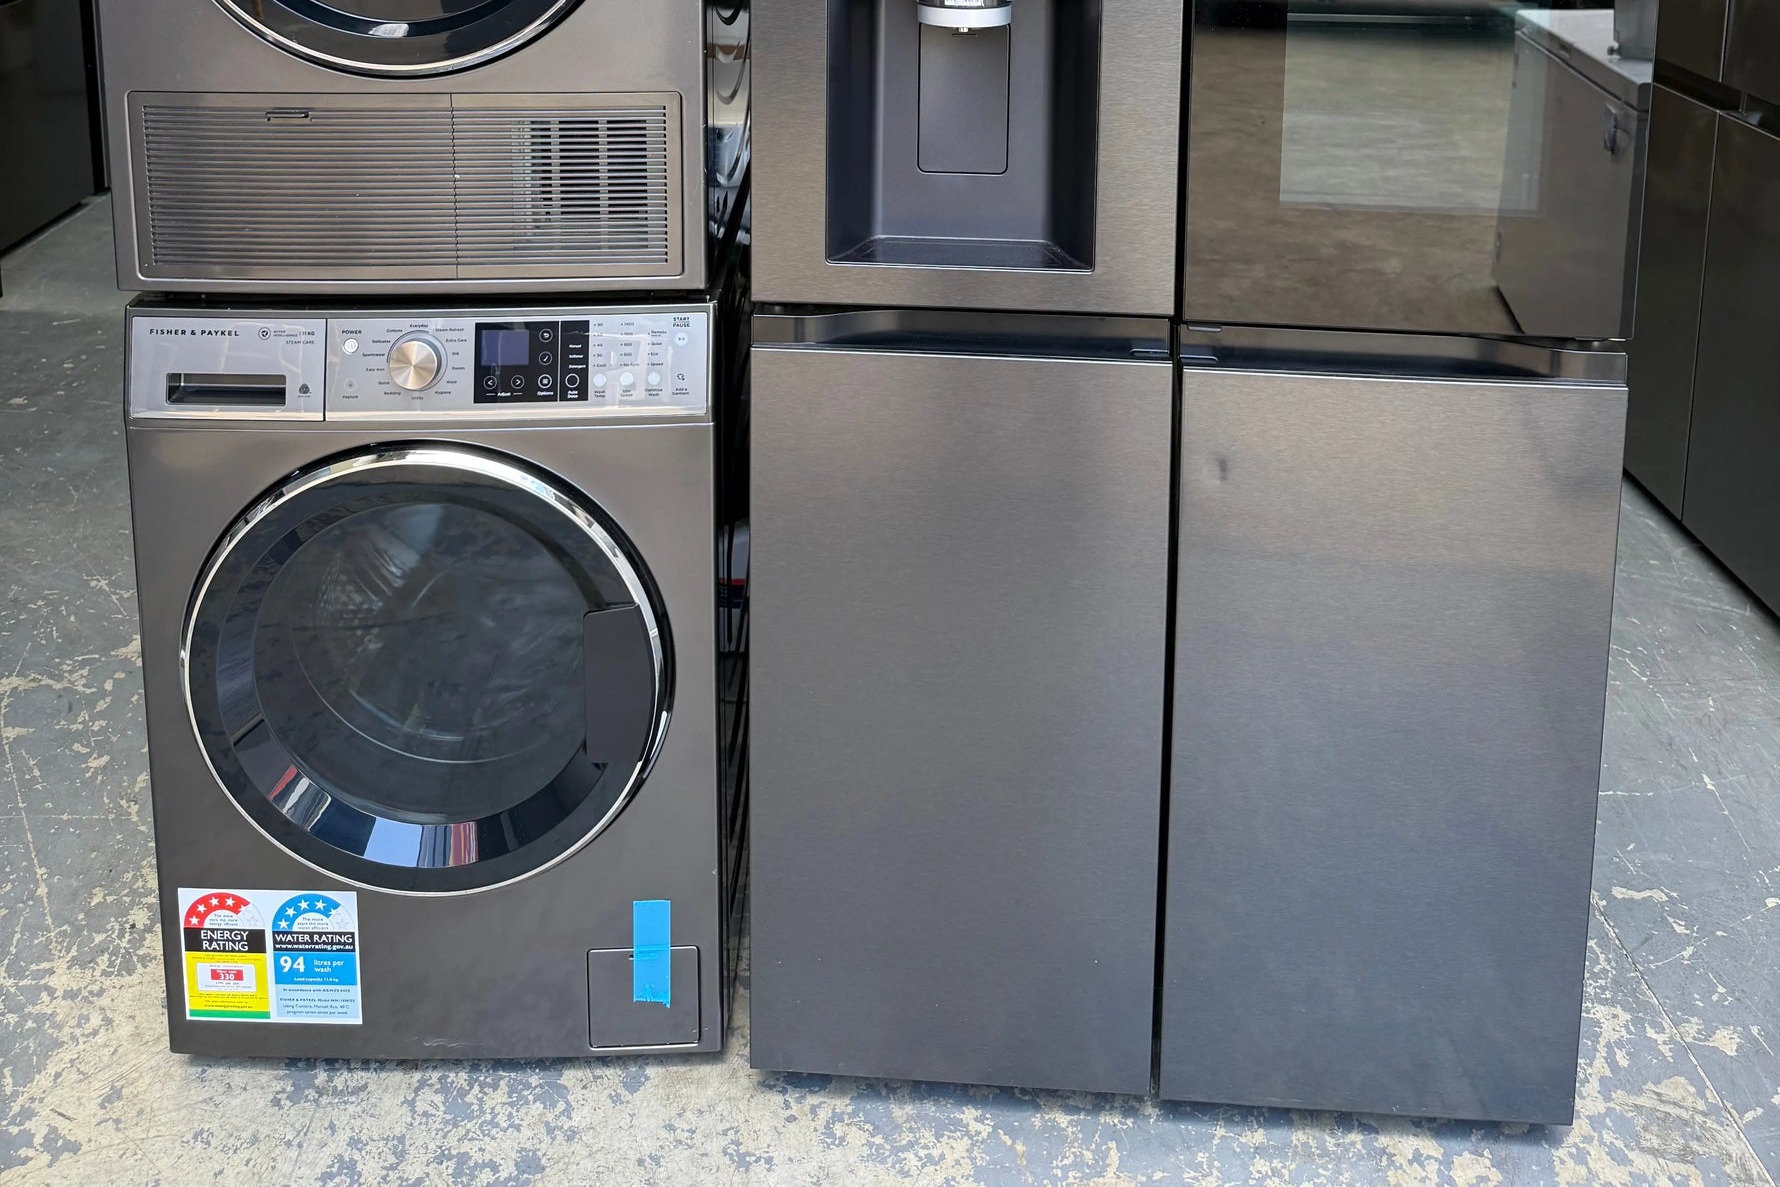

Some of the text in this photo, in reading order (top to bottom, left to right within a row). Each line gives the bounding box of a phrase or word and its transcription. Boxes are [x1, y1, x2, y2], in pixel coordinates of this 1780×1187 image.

[150, 328, 186, 336] FISHER
[201, 329, 239, 337] PAYKEL
[200, 930, 249, 941] ENERGY
[274, 934, 352, 943] WATER RATING
[203, 941, 249, 951] RATING
[280, 956, 305, 973] 94
